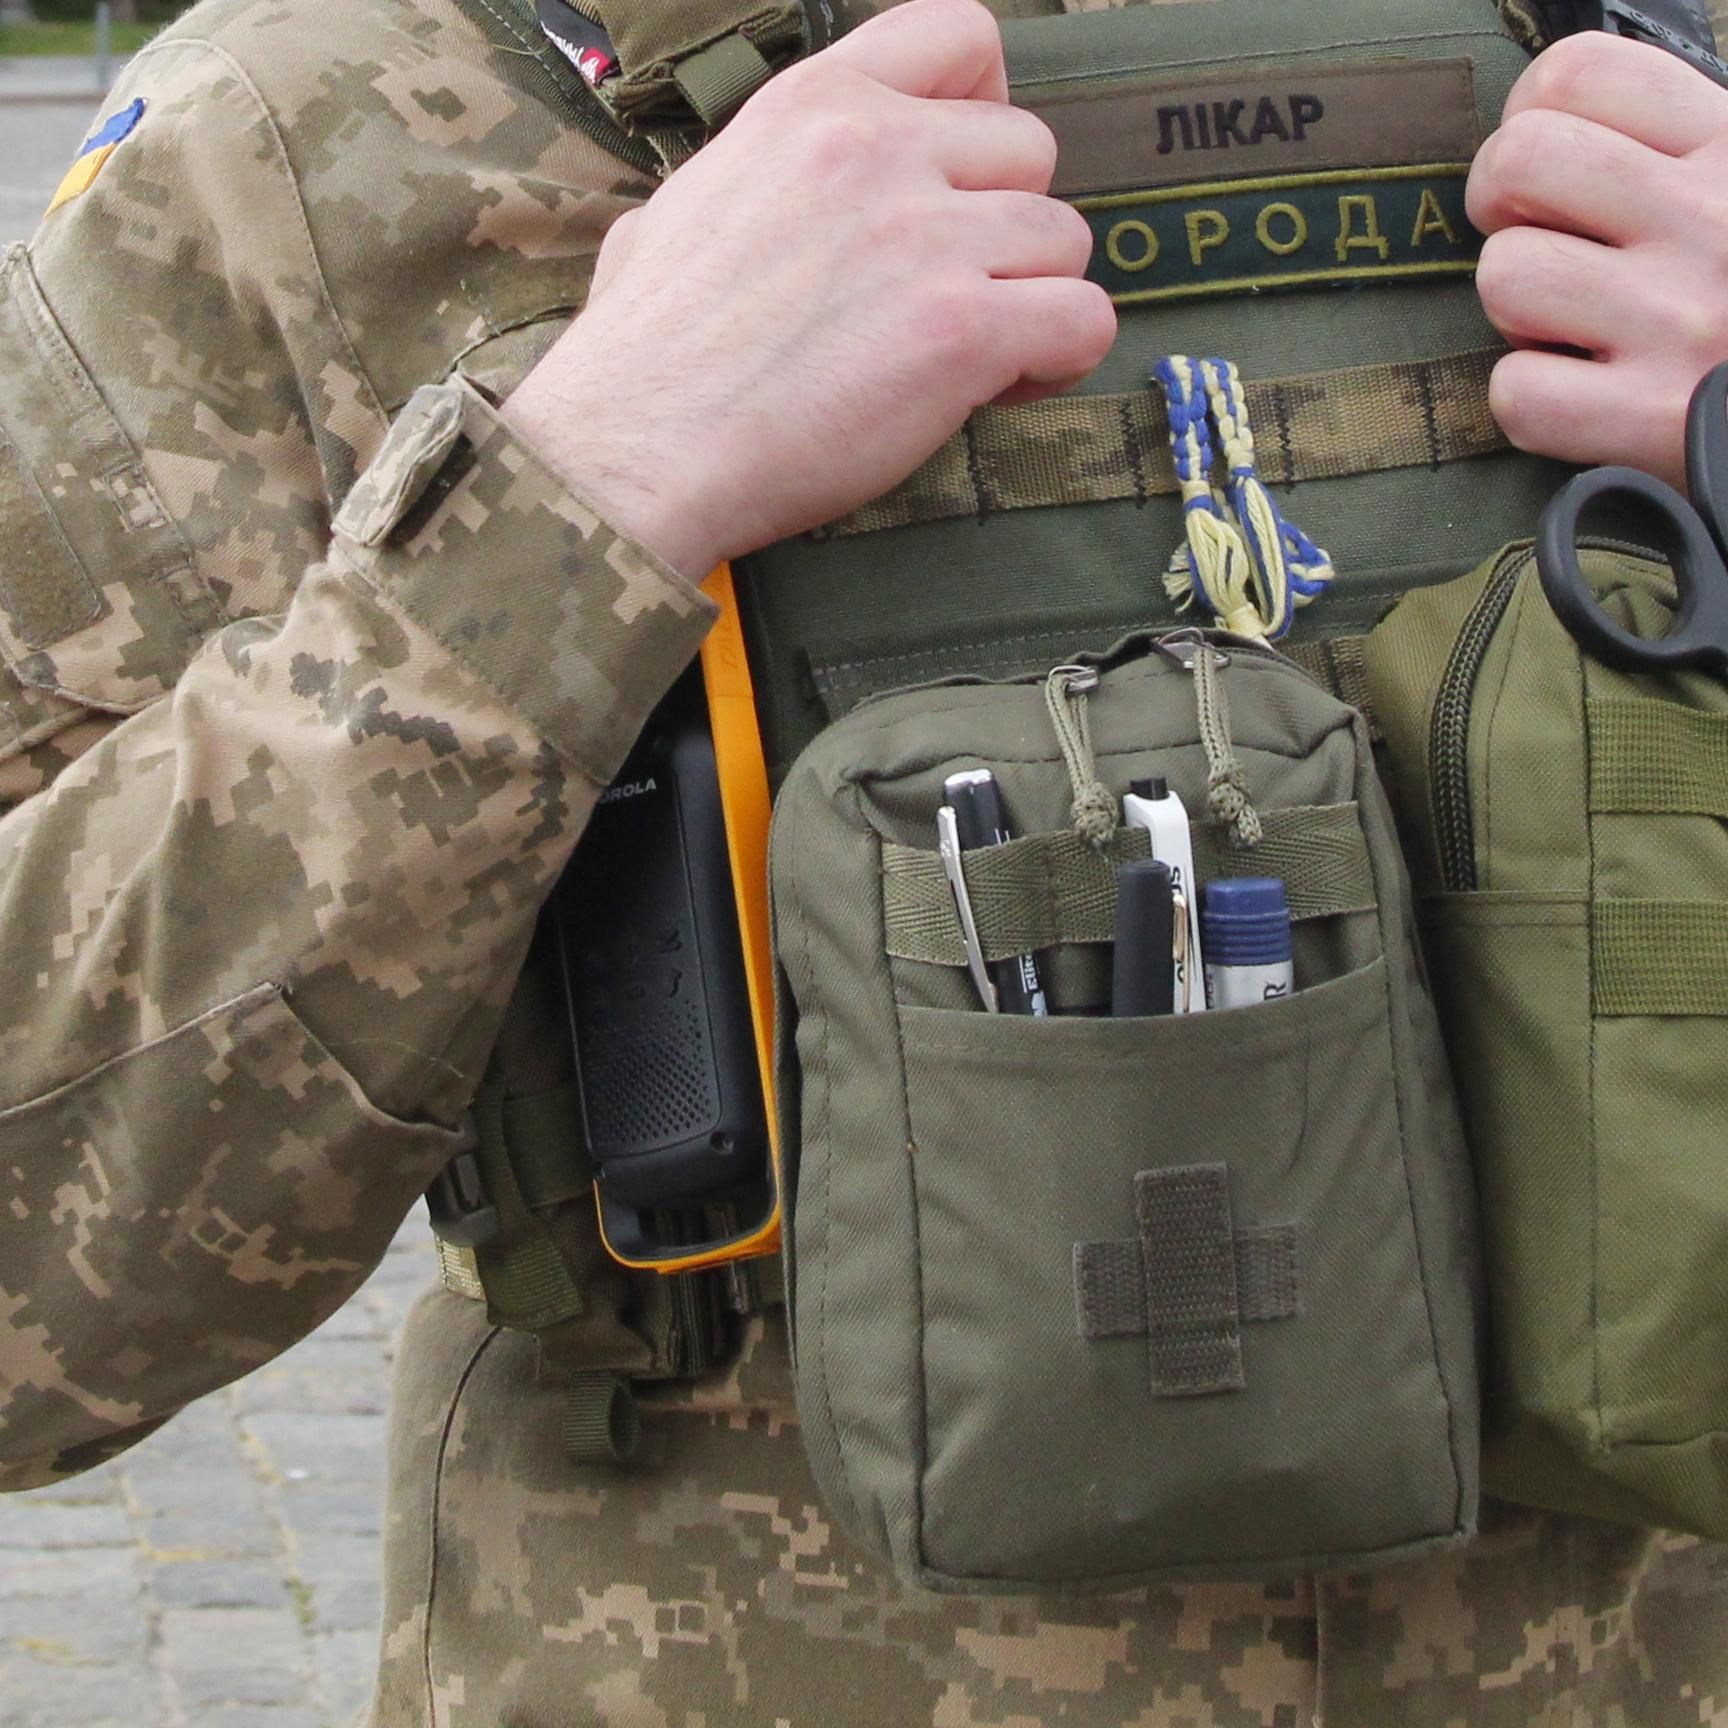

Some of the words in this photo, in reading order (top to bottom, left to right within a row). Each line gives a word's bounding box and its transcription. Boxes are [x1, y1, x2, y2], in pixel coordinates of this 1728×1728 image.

[1156, 94, 1325, 154] ЛІКАР
[1105, 189, 1461, 272] ОРОДА
[598, 777, 657, 804] OROLA
